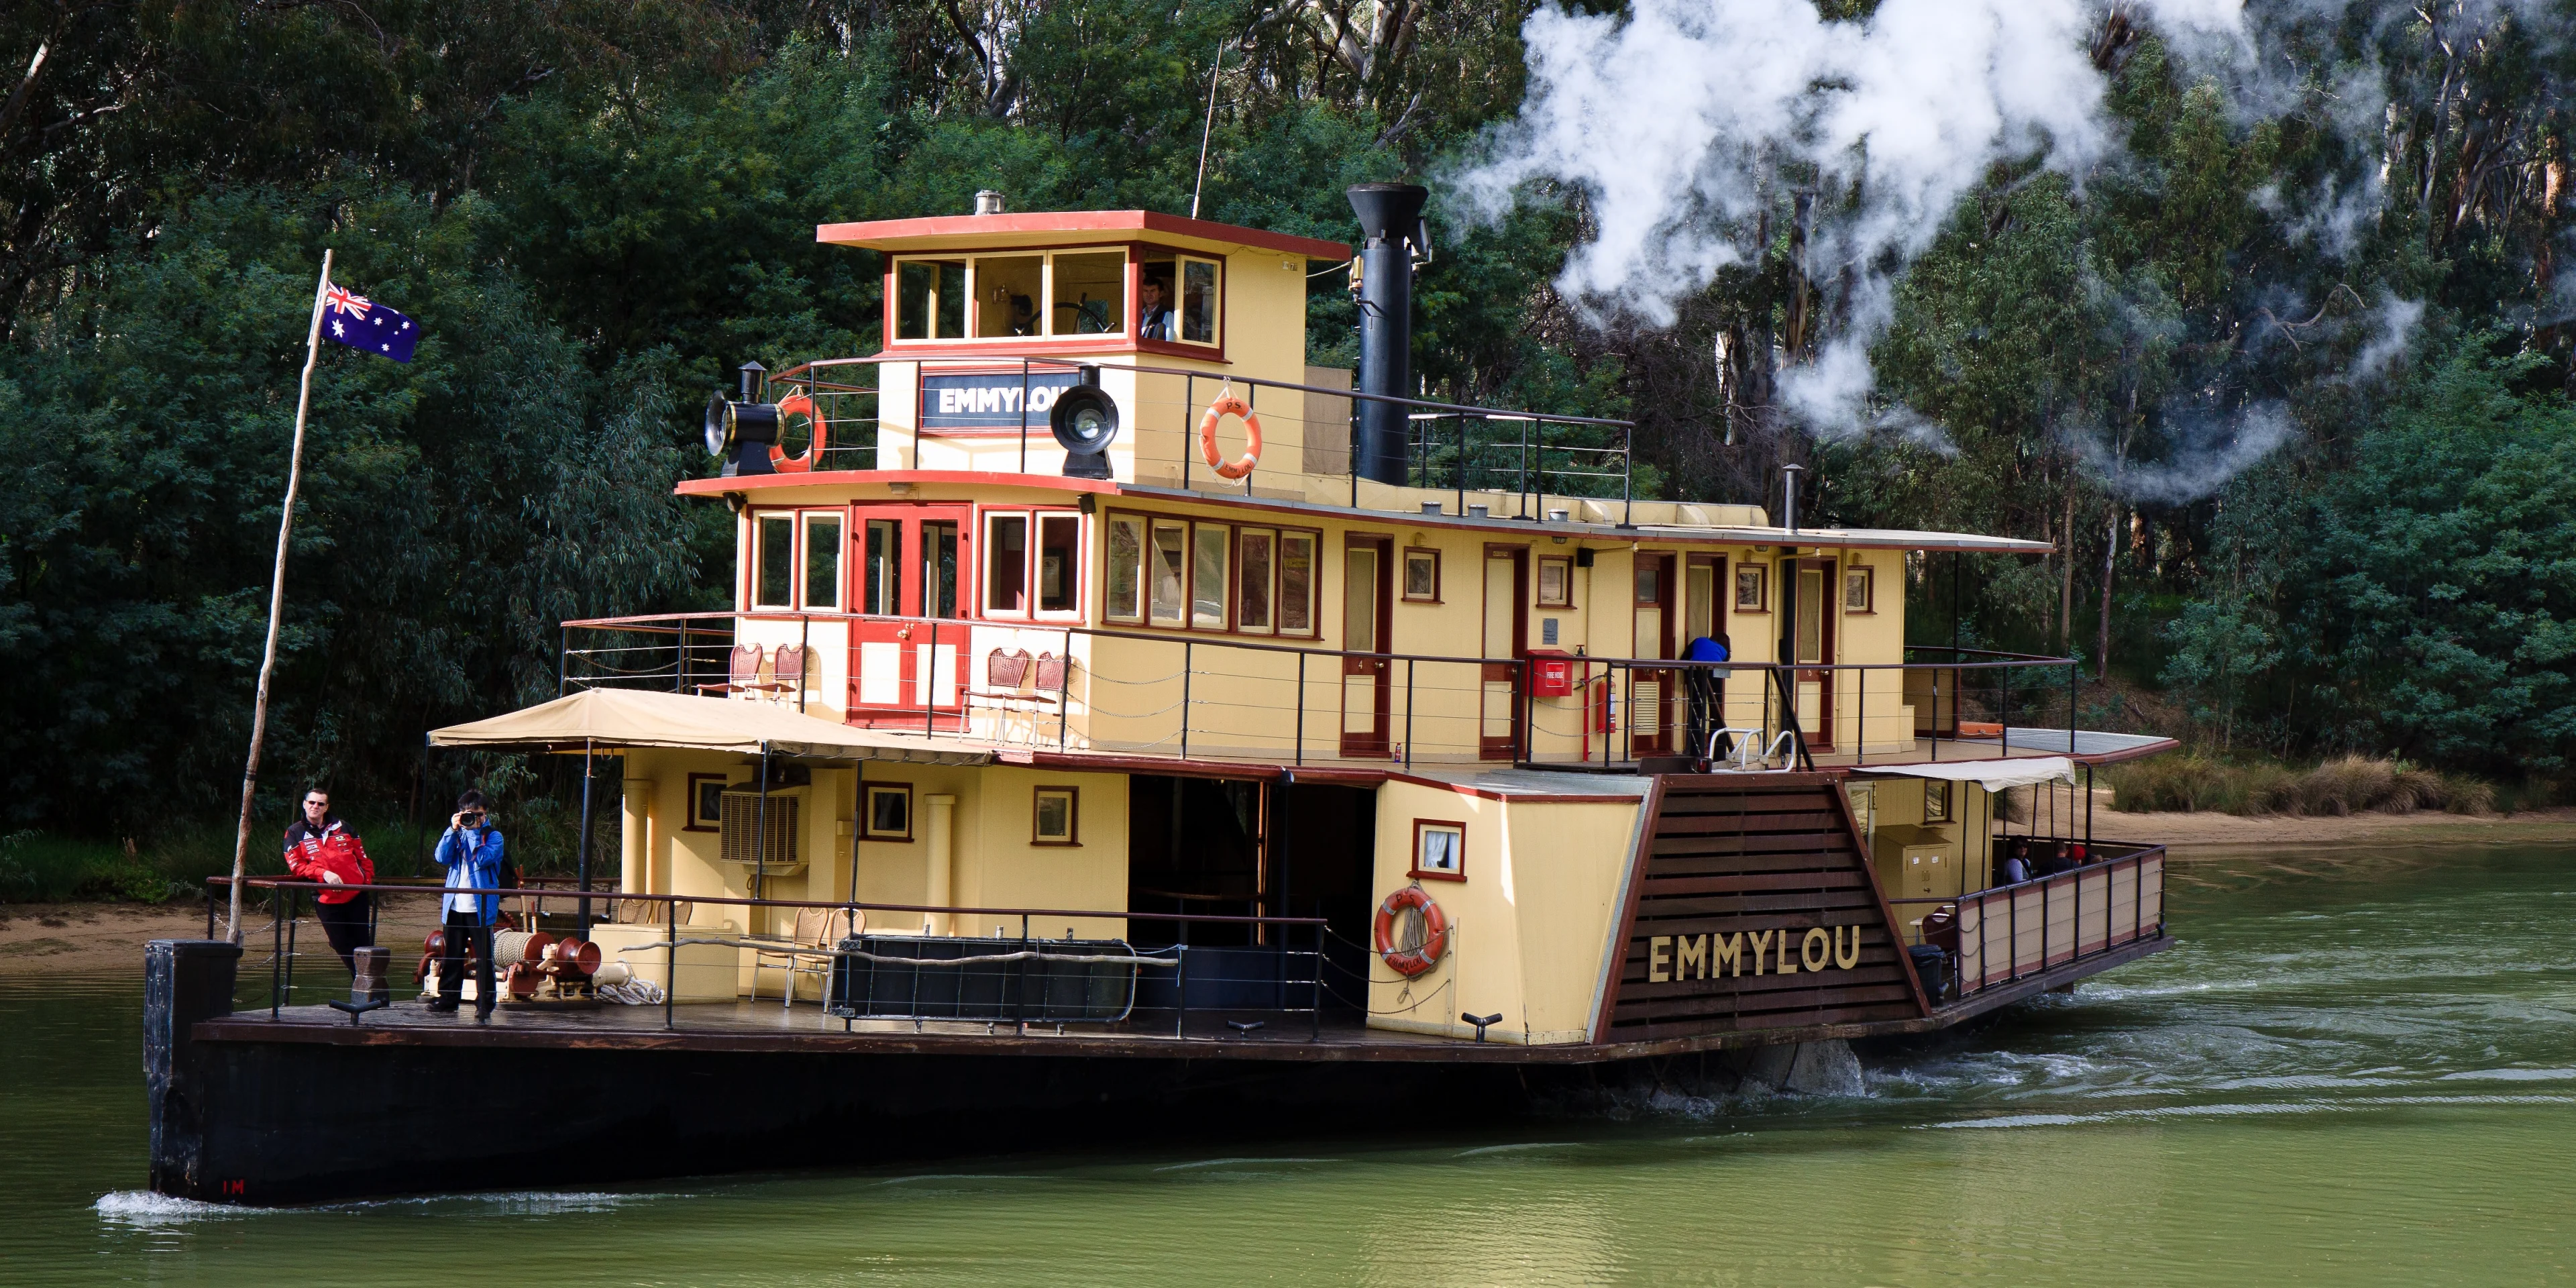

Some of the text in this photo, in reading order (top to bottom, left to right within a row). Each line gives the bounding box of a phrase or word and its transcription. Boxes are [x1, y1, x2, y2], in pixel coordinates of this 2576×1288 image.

[1224, 462, 1252, 474] EMMYLOU
[1358, 660, 1363, 669] 4
[1807, 669, 1812, 677] 6
[1649, 925, 1860, 983] EMMYLOU
